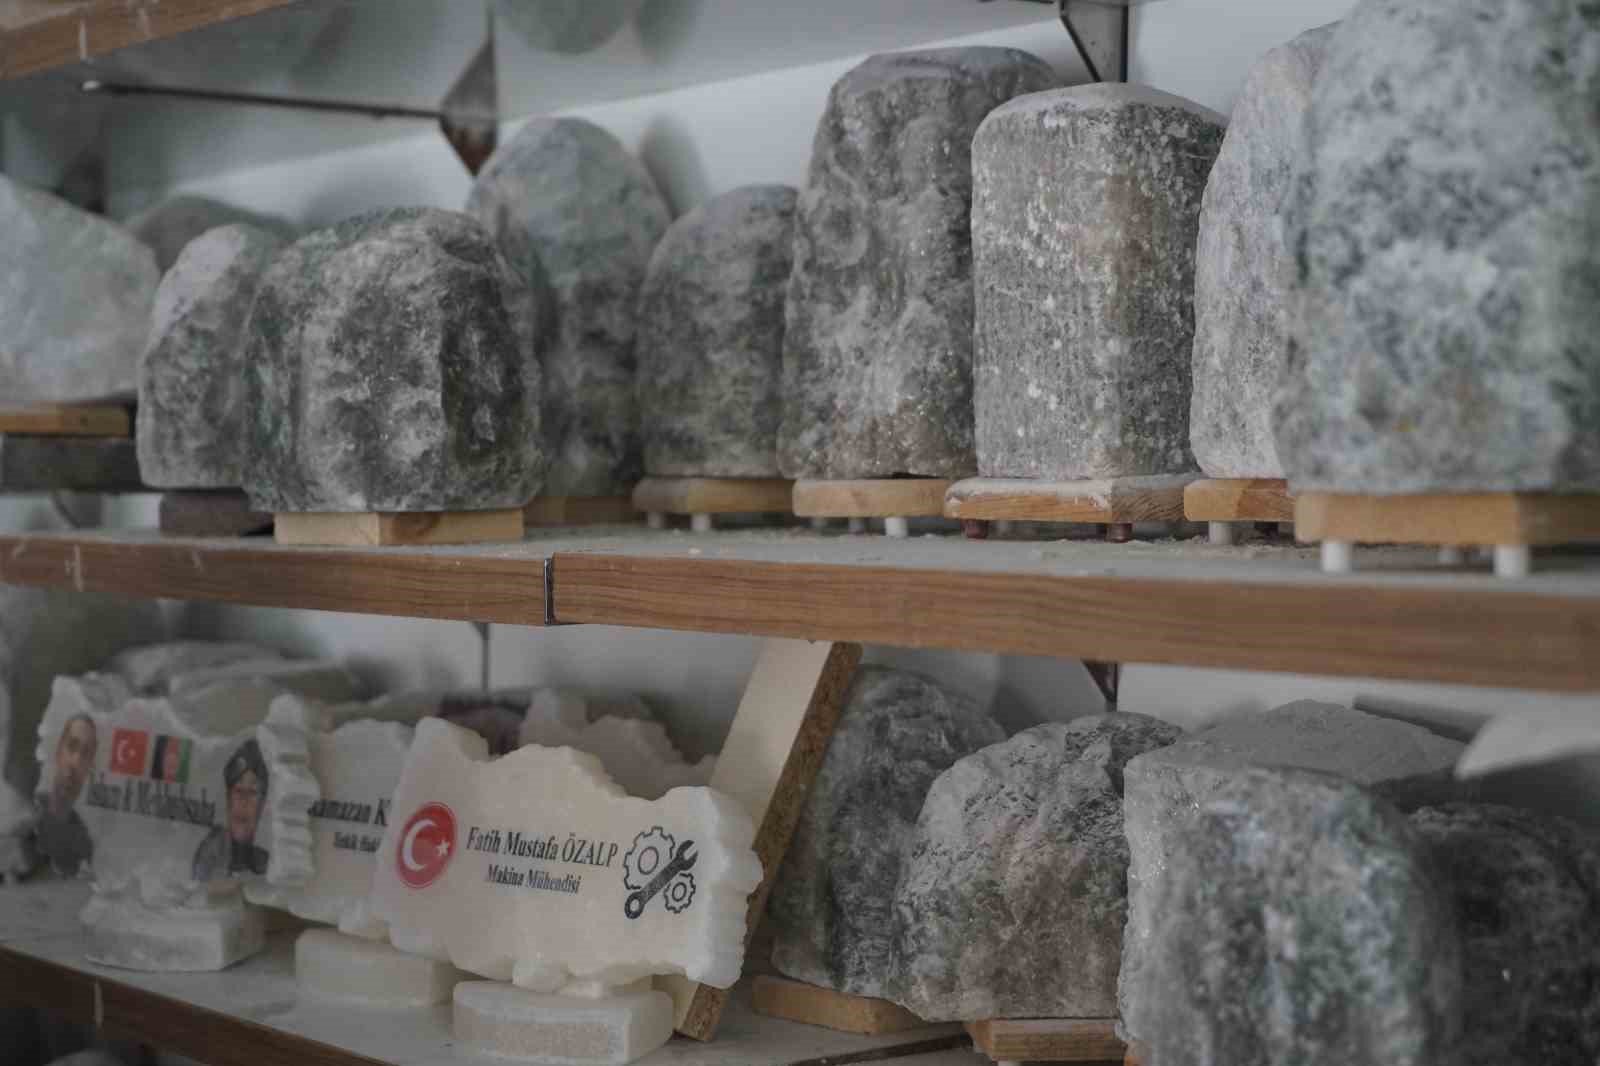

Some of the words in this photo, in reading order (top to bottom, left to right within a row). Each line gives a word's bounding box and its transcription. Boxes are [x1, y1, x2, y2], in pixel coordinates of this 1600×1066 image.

[306, 800, 370, 824] amazan
[466, 827, 502, 853] Fatih
[504, 831, 559, 860] Mustafa
[561, 832, 619, 867] ÖZALP
[487, 863, 525, 886] Makina
[527, 868, 582, 893] Mühendisi
